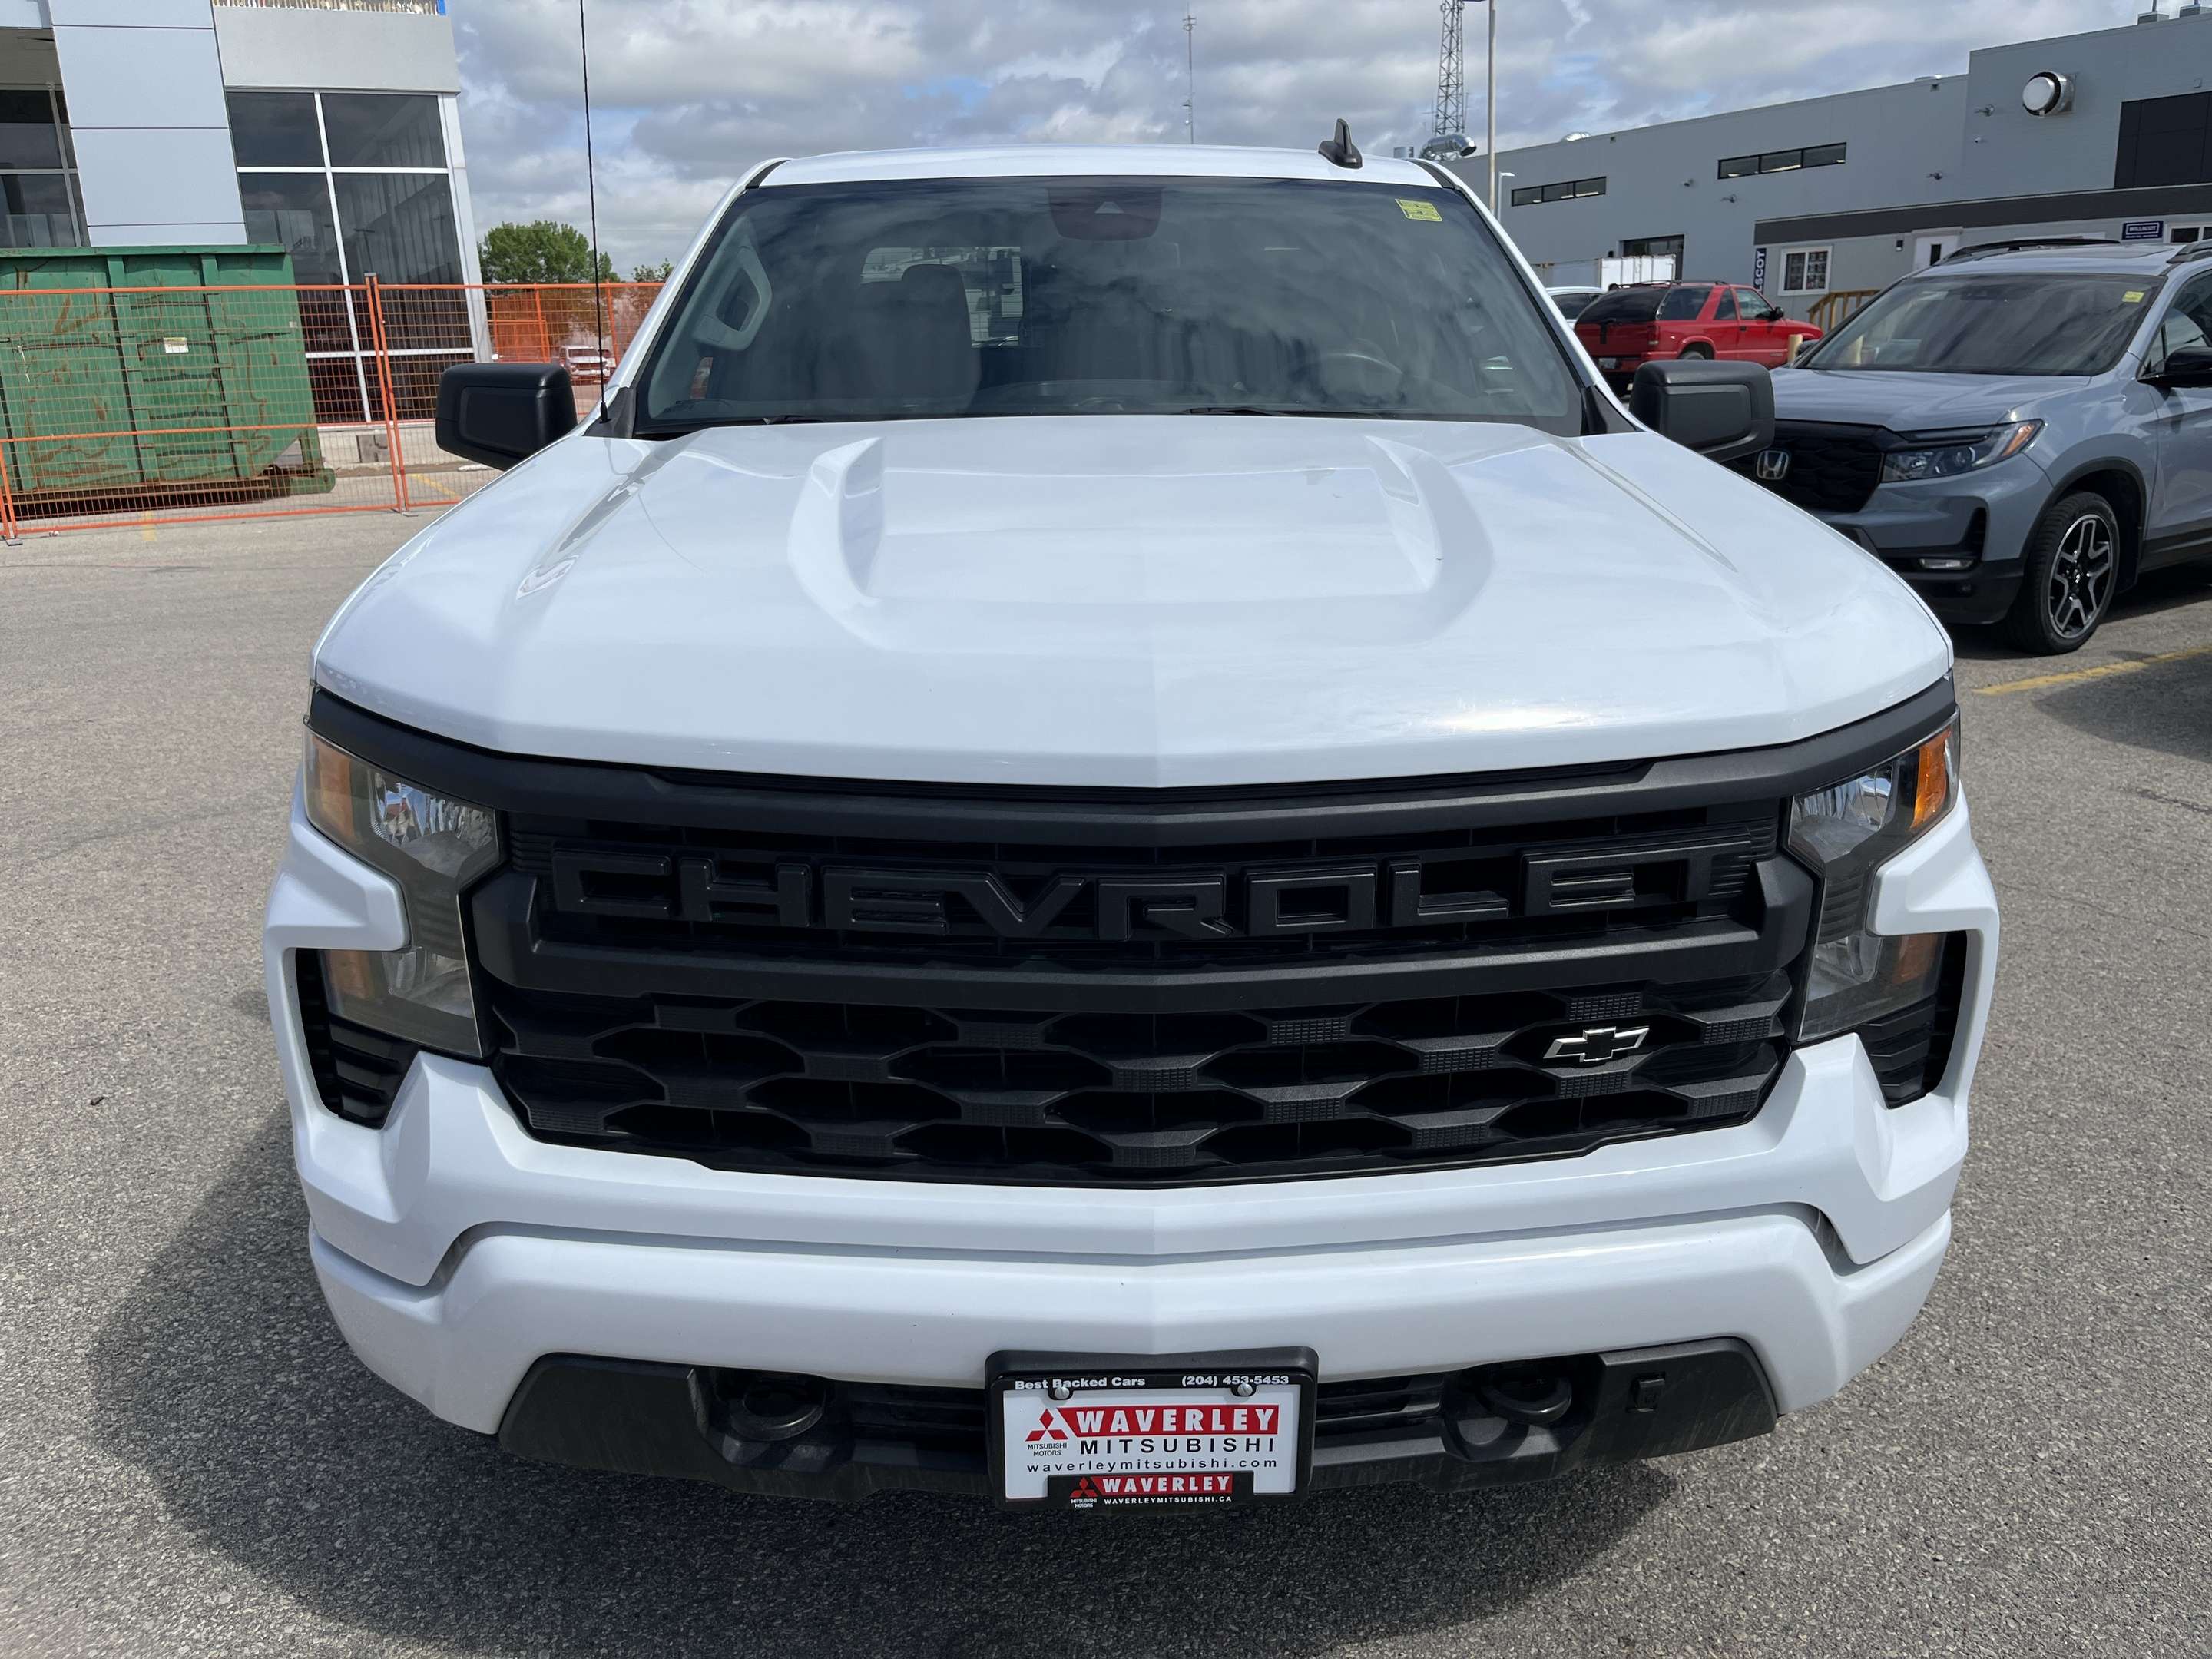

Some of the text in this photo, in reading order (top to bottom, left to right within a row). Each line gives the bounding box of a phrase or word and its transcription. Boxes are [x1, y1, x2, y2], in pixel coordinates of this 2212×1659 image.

[550, 827, 1754, 942] CHEVROLET
[1015, 1377, 1145, 1389] Best Backed Cars
[1181, 1375, 1290, 1386] (204) 453-5453
[1076, 1409, 1274, 1433] WAVERLEY
[1081, 1438, 1273, 1455] MITSUBISHI
[1027, 1458, 1277, 1472] waverleymitsubishi.com
[1103, 1475, 1230, 1493] WAVERLEY
[1104, 1496, 1232, 1505] WAVERLEYMITSUBISHI.CA
